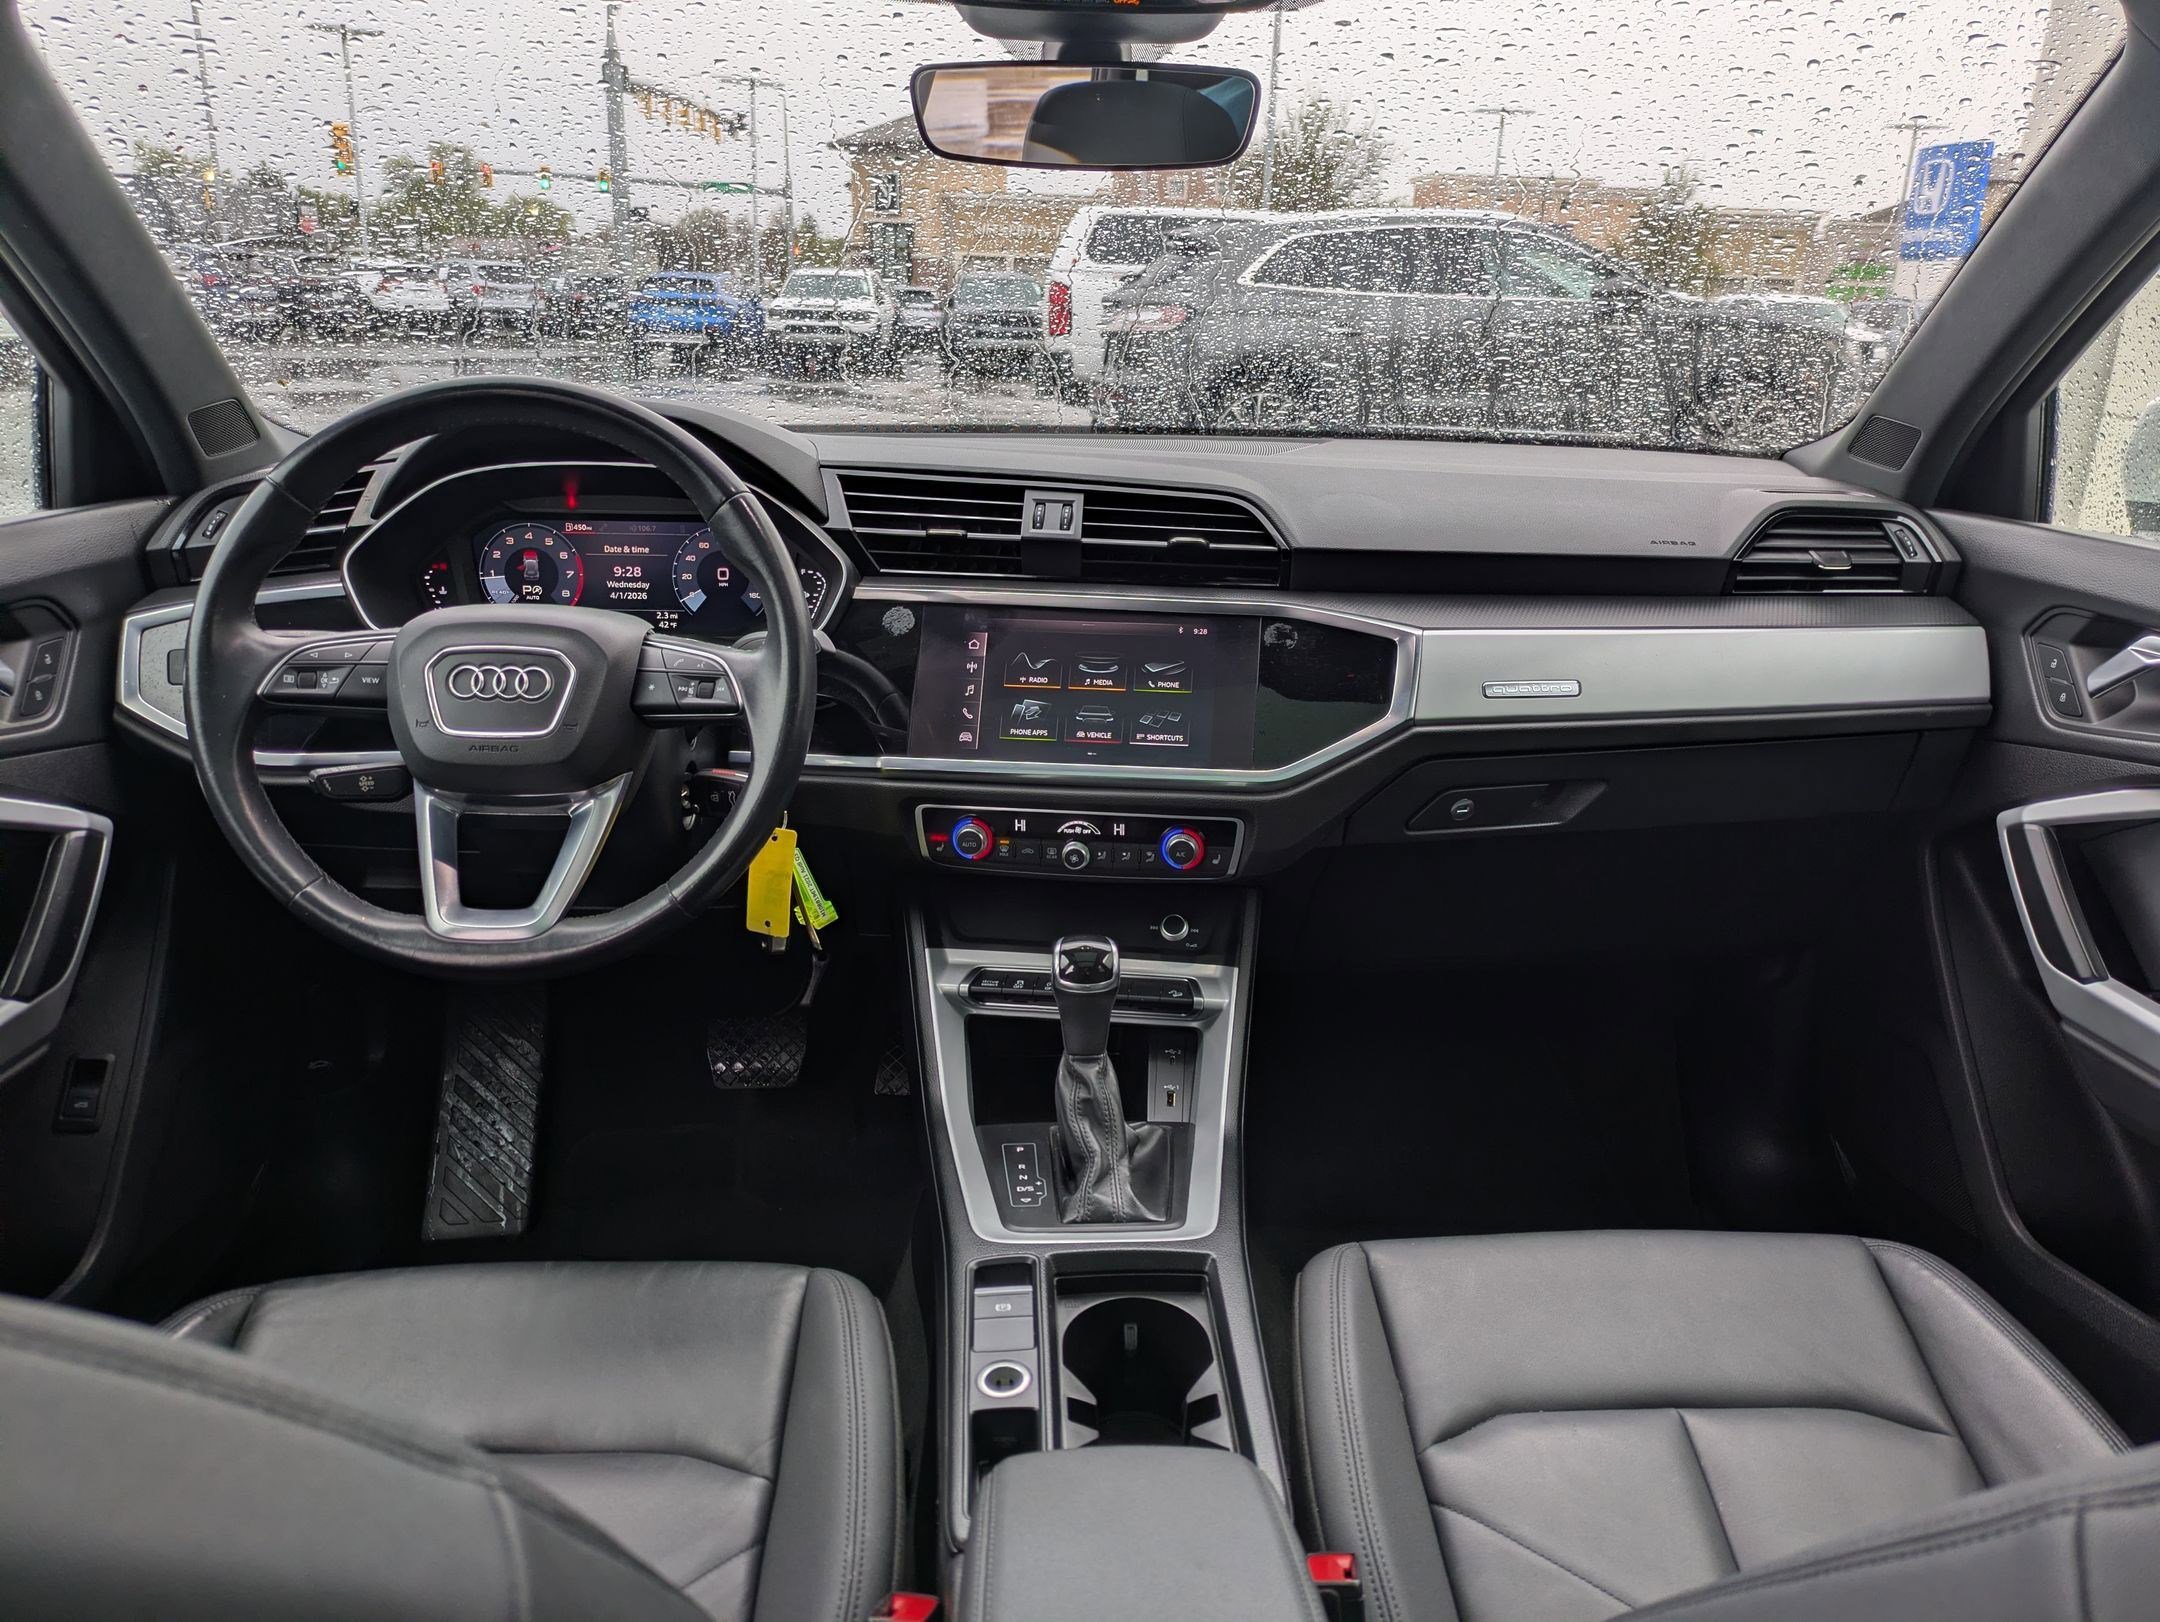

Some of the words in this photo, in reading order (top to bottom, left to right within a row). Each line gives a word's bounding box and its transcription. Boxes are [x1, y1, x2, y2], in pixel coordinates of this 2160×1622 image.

[506, 537, 514, 545] 3
[613, 566, 642, 577] 9:28
[717, 567, 729, 581] 0
[522, 586, 531, 595] P
[606, 581, 650, 590] Wednesday
[1493, 684, 1572, 695] quattro
[1146, 734, 1184, 742] SHORTCUTS
[1014, 819, 1026, 832] HI
[1113, 823, 1125, 836] HI
